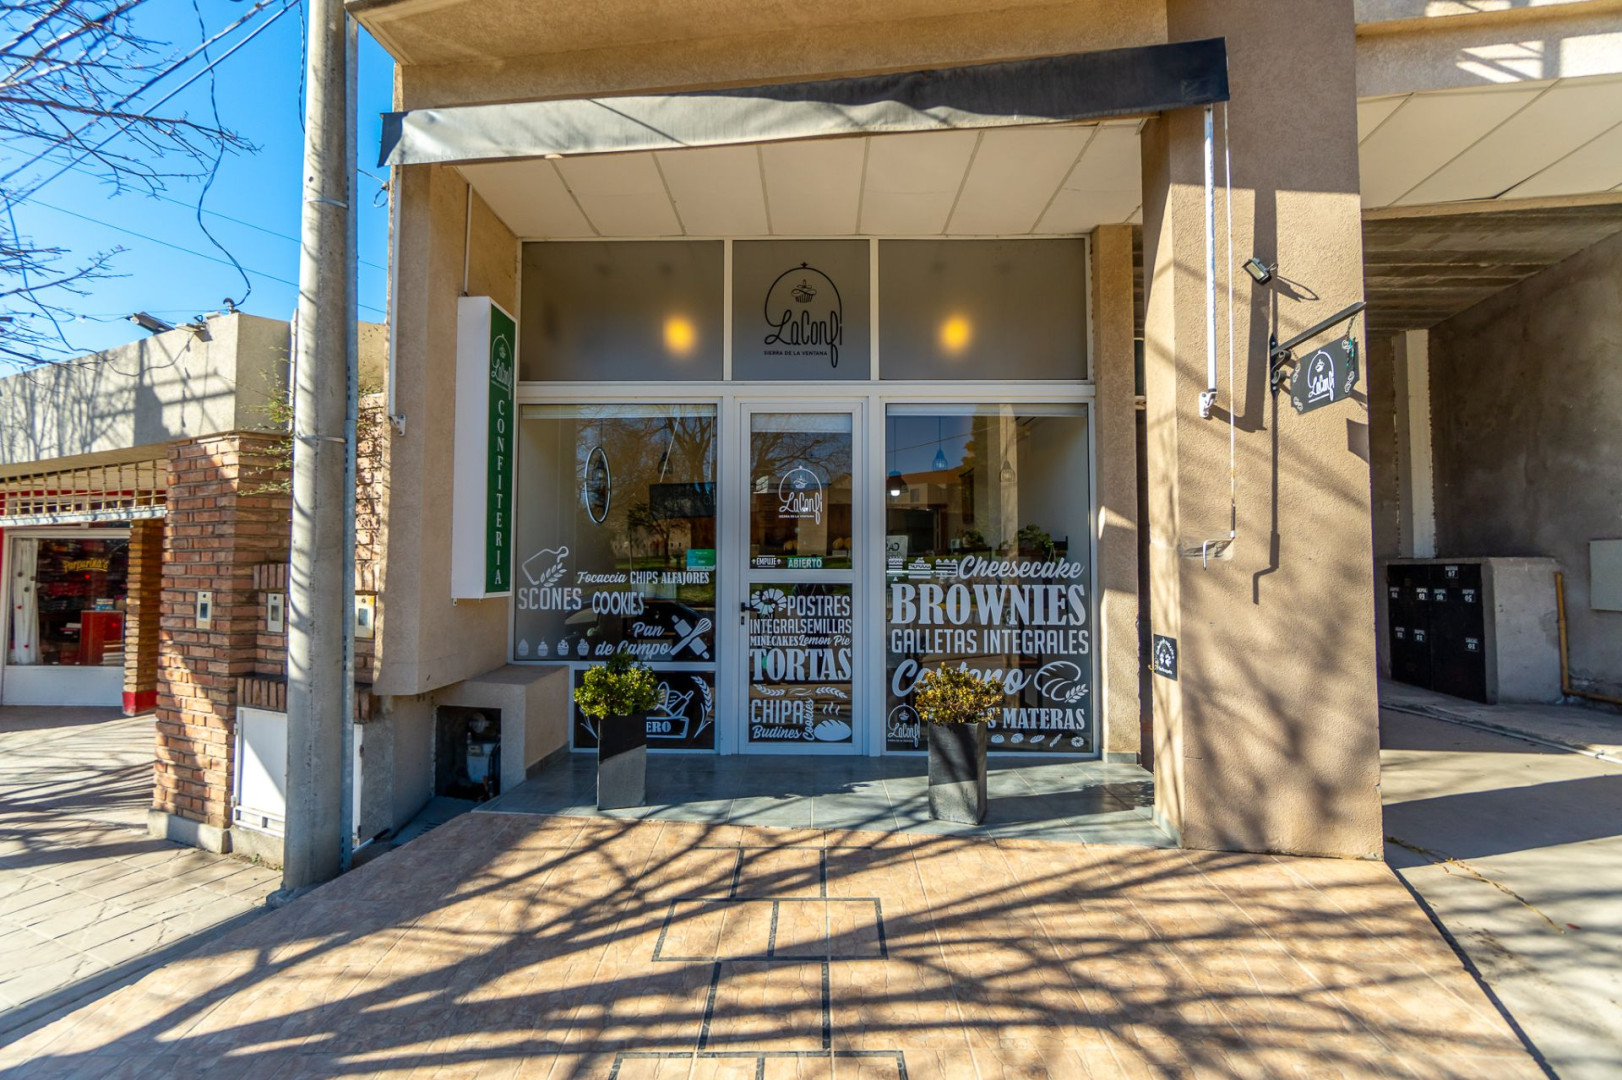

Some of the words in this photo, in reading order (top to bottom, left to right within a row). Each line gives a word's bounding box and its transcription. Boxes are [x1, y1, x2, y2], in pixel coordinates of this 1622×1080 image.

[496, 400, 505, 584] CONFITERIA
[787, 559, 822, 568] ABIERTO
[959, 555, 1085, 580] Cheesecake
[577, 571, 627, 584] Focaccia
[630, 571, 658, 584] CHIPS
[661, 571, 710, 586] ALFAJORES
[518, 587, 582, 610] SCONES
[592, 591, 645, 615] COOKIES
[787, 595, 851, 617] POSTRES
[890, 583, 1087, 626] BROWNIES
[632, 621, 665, 638] Pan
[750, 618, 800, 634] INTEGRAL
[800, 618, 852, 634] SEMILLAS
[594, 641, 615, 656] de
[616, 640, 672, 660] Campo
[799, 634, 832, 647] Lemon
[833, 635, 851, 646] Pie
[891, 629, 977, 654] GALLETAS
[983, 629, 1089, 655] INTEGRALES
[750, 648, 852, 681] TORTAS
[751, 699, 803, 723] CHIPA
[802, 697, 815, 740] Cookies
[1002, 708, 1085, 730] MATERAS
[752, 725, 802, 739] Budines
